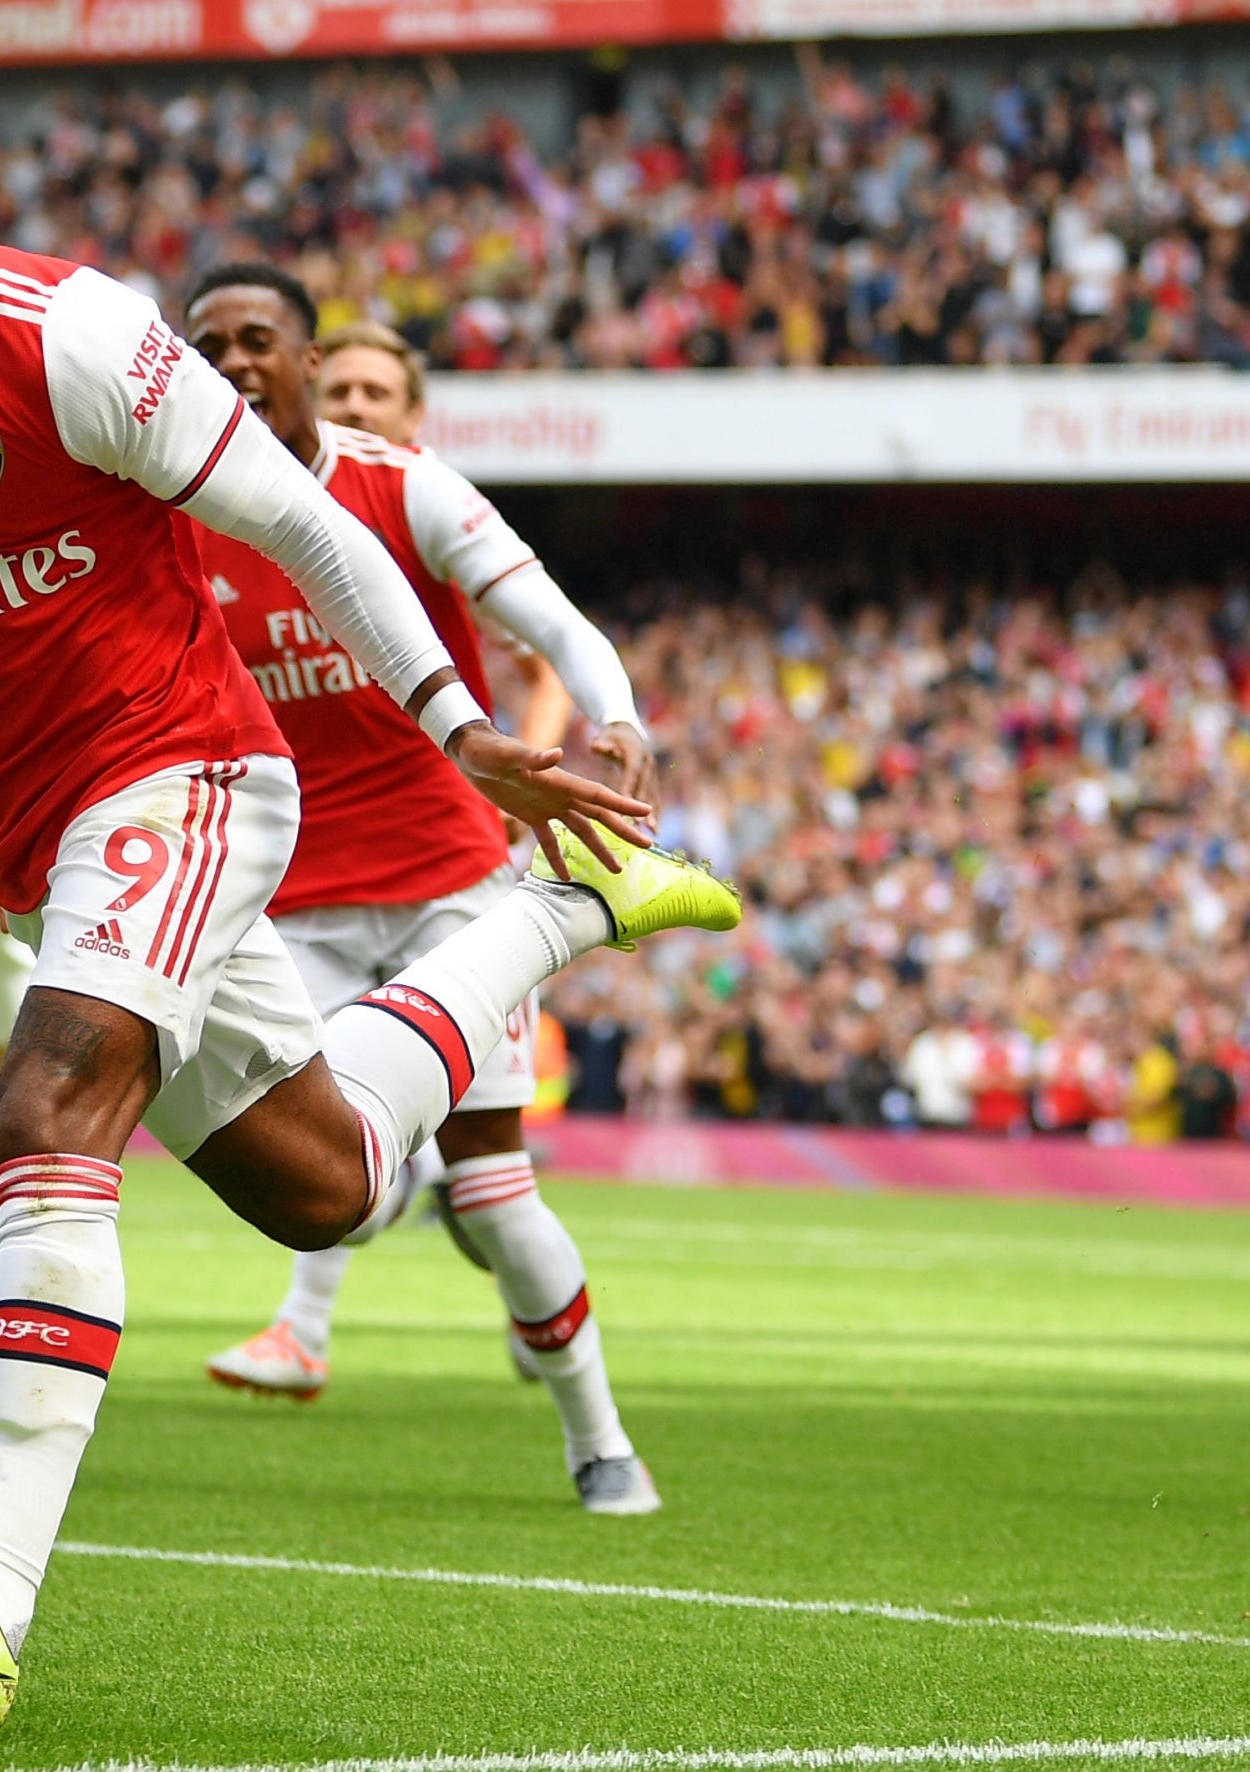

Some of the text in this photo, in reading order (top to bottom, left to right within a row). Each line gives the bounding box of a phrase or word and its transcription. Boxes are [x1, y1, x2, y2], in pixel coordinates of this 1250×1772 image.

[127, 320, 165, 380] VISIT
[132, 335, 183, 425] RWAN
[104, 826, 170, 912] 9
[74, 936, 131, 960] adidas
